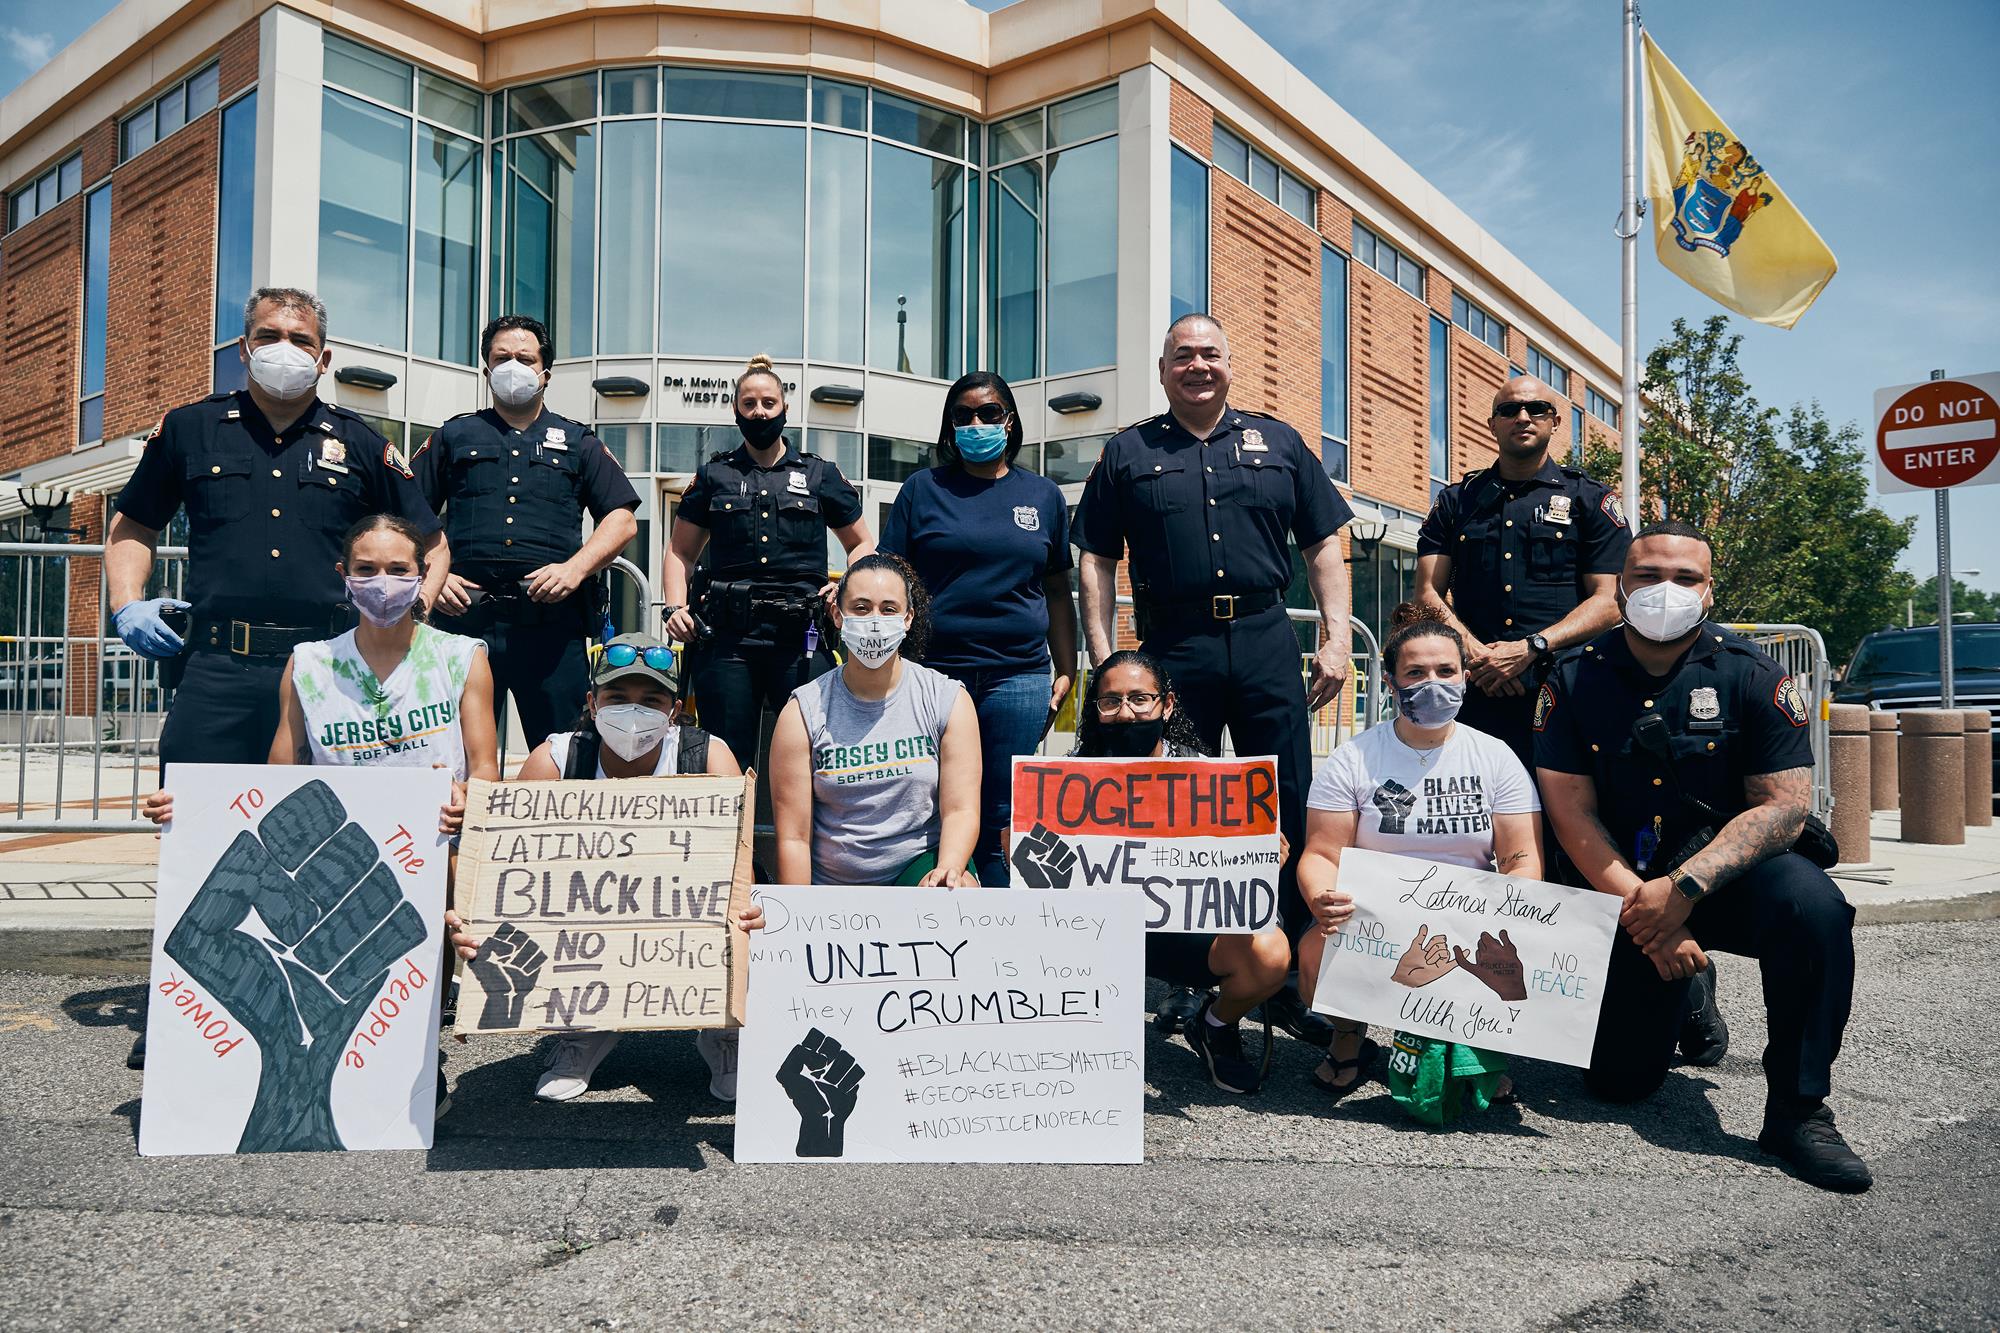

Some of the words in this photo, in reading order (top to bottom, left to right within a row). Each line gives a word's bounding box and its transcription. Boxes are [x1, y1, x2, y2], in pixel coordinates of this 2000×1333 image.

[664, 376, 687, 387] Det.
[690, 377, 728, 389] Melvin
[682, 392, 719, 403] WEST
[1895, 405, 1924, 424] DO
[1940, 398, 1984, 419] NOT
[1904, 447, 1976, 470] ENTER
[870, 621, 880, 633] I
[321, 714, 404, 747] JERSEY
[408, 701, 451, 732] CITY
[353, 739, 429, 761] SOFTBALL
[816, 742, 888, 770] JERSEY
[837, 766, 912, 785] SOFTBALL
[1424, 776, 1483, 796] BLACK
[1022, 765, 1278, 829] TOGETHER
[1428, 795, 1483, 817] LIVES
[1417, 814, 1491, 834] MATTER
[384, 824, 426, 876] The
[491, 831, 637, 863] LATINOS
[670, 830, 692, 862] 4
[1076, 840, 1146, 887] WE
[494, 868, 643, 918] BLACK
[1142, 875, 1275, 931] STAND
[1398, 865, 1487, 915] Latinos
[1494, 883, 1562, 926] Stand
[916, 906, 940, 929] is
[956, 902, 1016, 928] how
[1039, 902, 1107, 941] they
[1359, 920, 1385, 940] NO
[553, 929, 606, 961] NO
[1332, 931, 1401, 961] JUSTICE
[749, 948, 793, 963] win
[806, 940, 969, 984] UNITY
[993, 956, 1019, 978] is
[1042, 955, 1092, 979] how
[1551, 951, 1578, 973] NO
[1531, 969, 1588, 1000] PEACE
[545, 980, 610, 1027] NO
[622, 981, 723, 1019] PEACE
[788, 996, 853, 1027] they
[1400, 991, 1455, 1034] With
[898, 1050, 1141, 1079] #BLACKLIVESMATTER
[903, 1080, 1075, 1106] #GEORGEFLOYD
[908, 1109, 1122, 1141] #NOJUSTICENOPEACE
